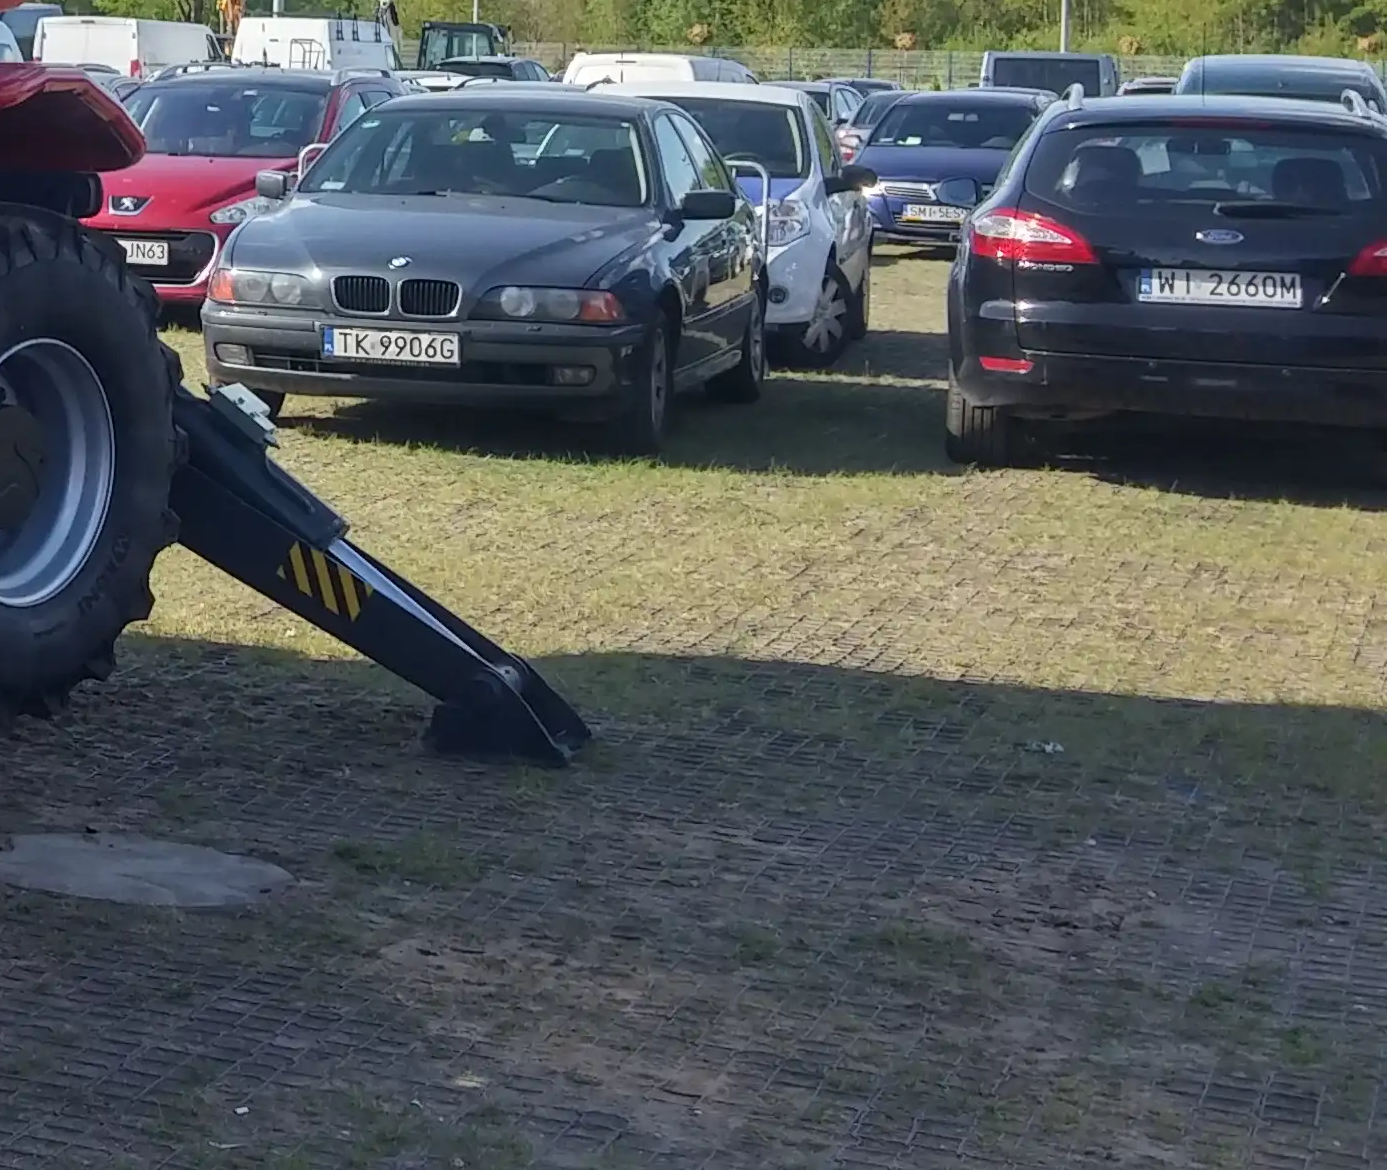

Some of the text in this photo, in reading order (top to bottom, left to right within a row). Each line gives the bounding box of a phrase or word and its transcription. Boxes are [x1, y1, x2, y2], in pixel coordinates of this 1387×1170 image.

[1208, 273, 1297, 300] 2660M
[338, 331, 370, 356] TK
[379, 334, 455, 360] 9906G
